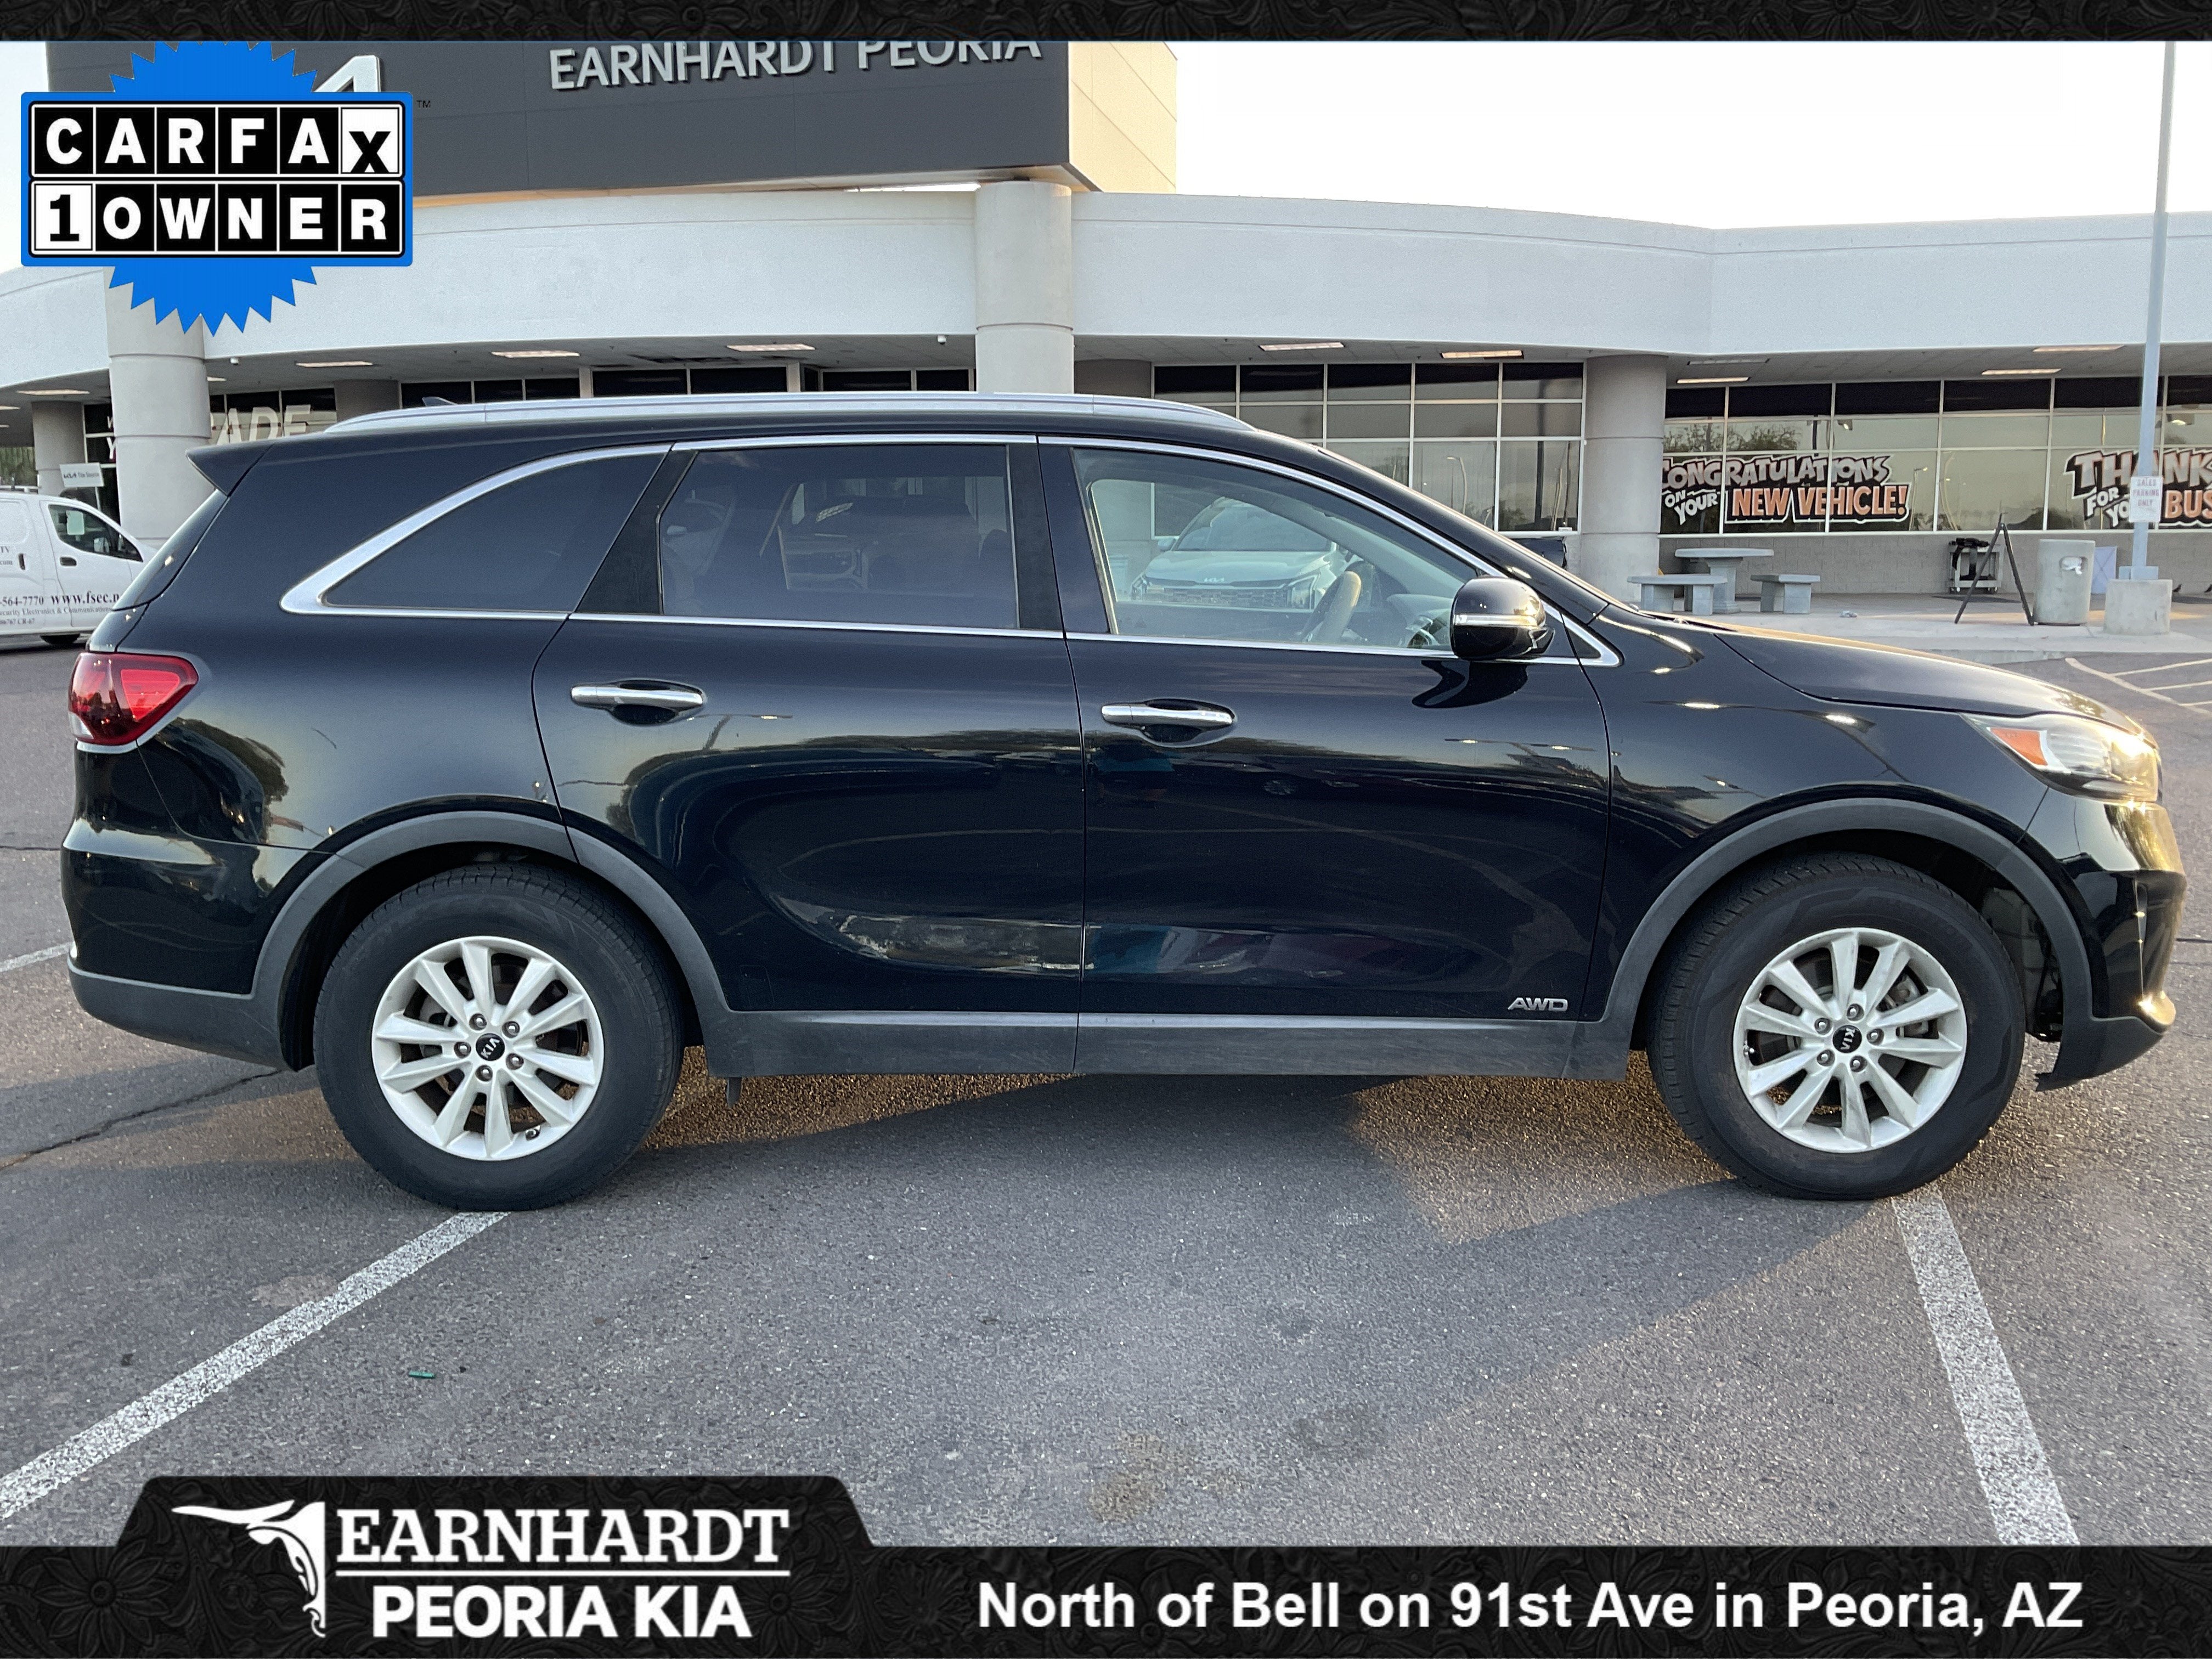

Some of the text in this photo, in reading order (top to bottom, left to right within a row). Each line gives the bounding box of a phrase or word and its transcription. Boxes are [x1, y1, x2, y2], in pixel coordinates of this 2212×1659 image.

[550, 41, 834, 89] EARNHARDT
[211, 404, 311, 445] ADE
[2075, 451, 2212, 488] THNK
[1664, 489, 1686, 508] ON
[1674, 492, 1718, 526] YOUR
[1731, 486, 1908, 516] NEW VEHICLE!
[2086, 487, 2120, 517] FOR
[1508, 997, 1568, 1012] AWD
[481, 1038, 500, 1059] KIA
[1839, 1028, 1855, 1050] KIA
